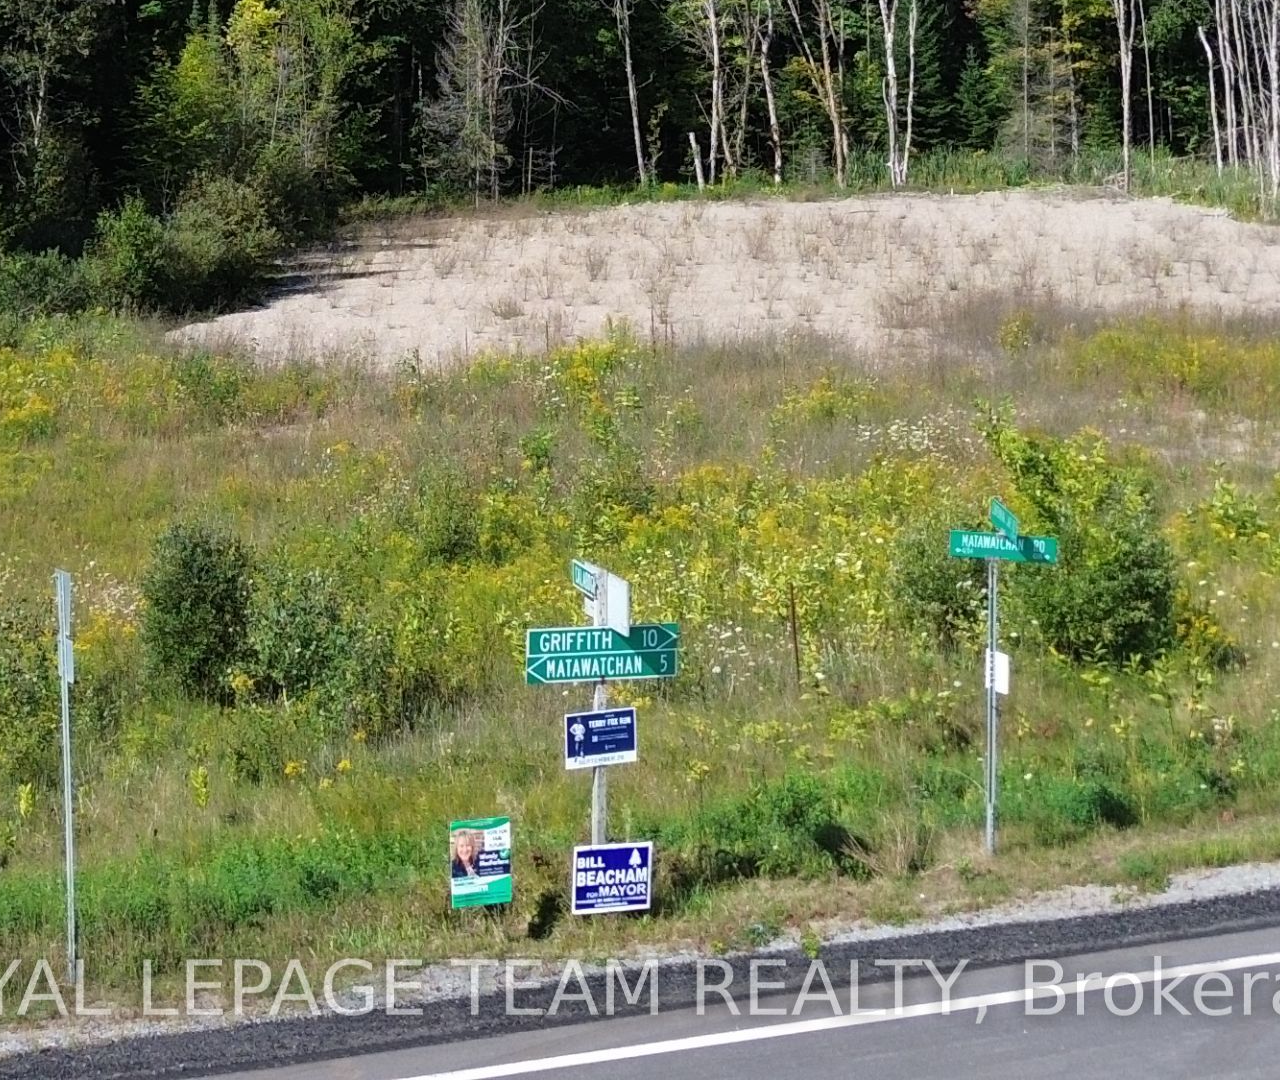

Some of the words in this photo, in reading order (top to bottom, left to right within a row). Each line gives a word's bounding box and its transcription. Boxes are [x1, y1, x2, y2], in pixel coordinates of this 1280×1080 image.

[1033, 539, 1046, 554] RD
[539, 631, 612, 652] GRIFFITH
[642, 628, 658, 647] 10
[546, 656, 642, 679] MATAWATCHAN
[659, 654, 668, 673] 5
[577, 856, 606, 869] BILL
[576, 867, 648, 887] BEACHAM
[598, 883, 646, 897] MAYOR
